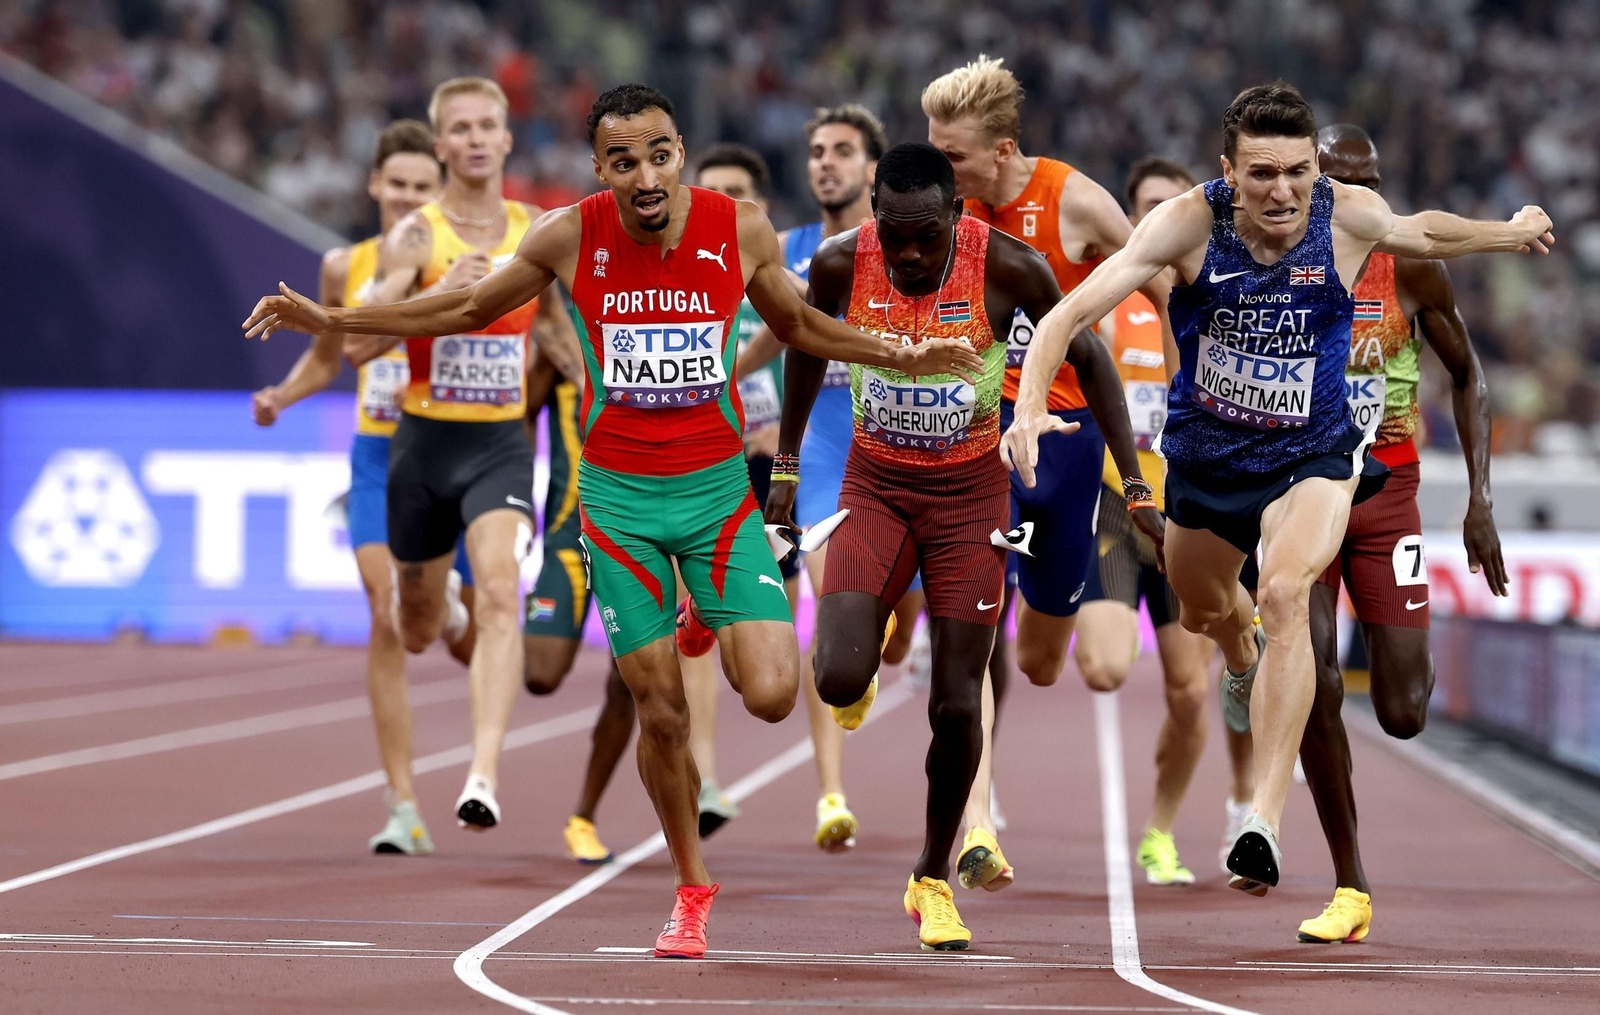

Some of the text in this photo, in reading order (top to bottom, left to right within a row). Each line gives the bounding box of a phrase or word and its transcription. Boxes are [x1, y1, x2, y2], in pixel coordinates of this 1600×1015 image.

[593, 269, 606, 278] FPA
[602, 289, 715, 316] PORTUGAL
[1238, 293, 1291, 305] Novuna
[1213, 308, 1312, 333] GREAT
[463, 339, 518, 359] TDK
[635, 326, 715, 353] TDK
[1208, 321, 1315, 355] BRITAIN
[612, 355, 718, 384] NADER
[1228, 350, 1306, 383] TDK
[886, 384, 966, 408] TDK
[1201, 363, 1305, 414] WIGHTMAN
[878, 408, 970, 433] CHERUIYOT
[1405, 544, 1420, 578] 7
